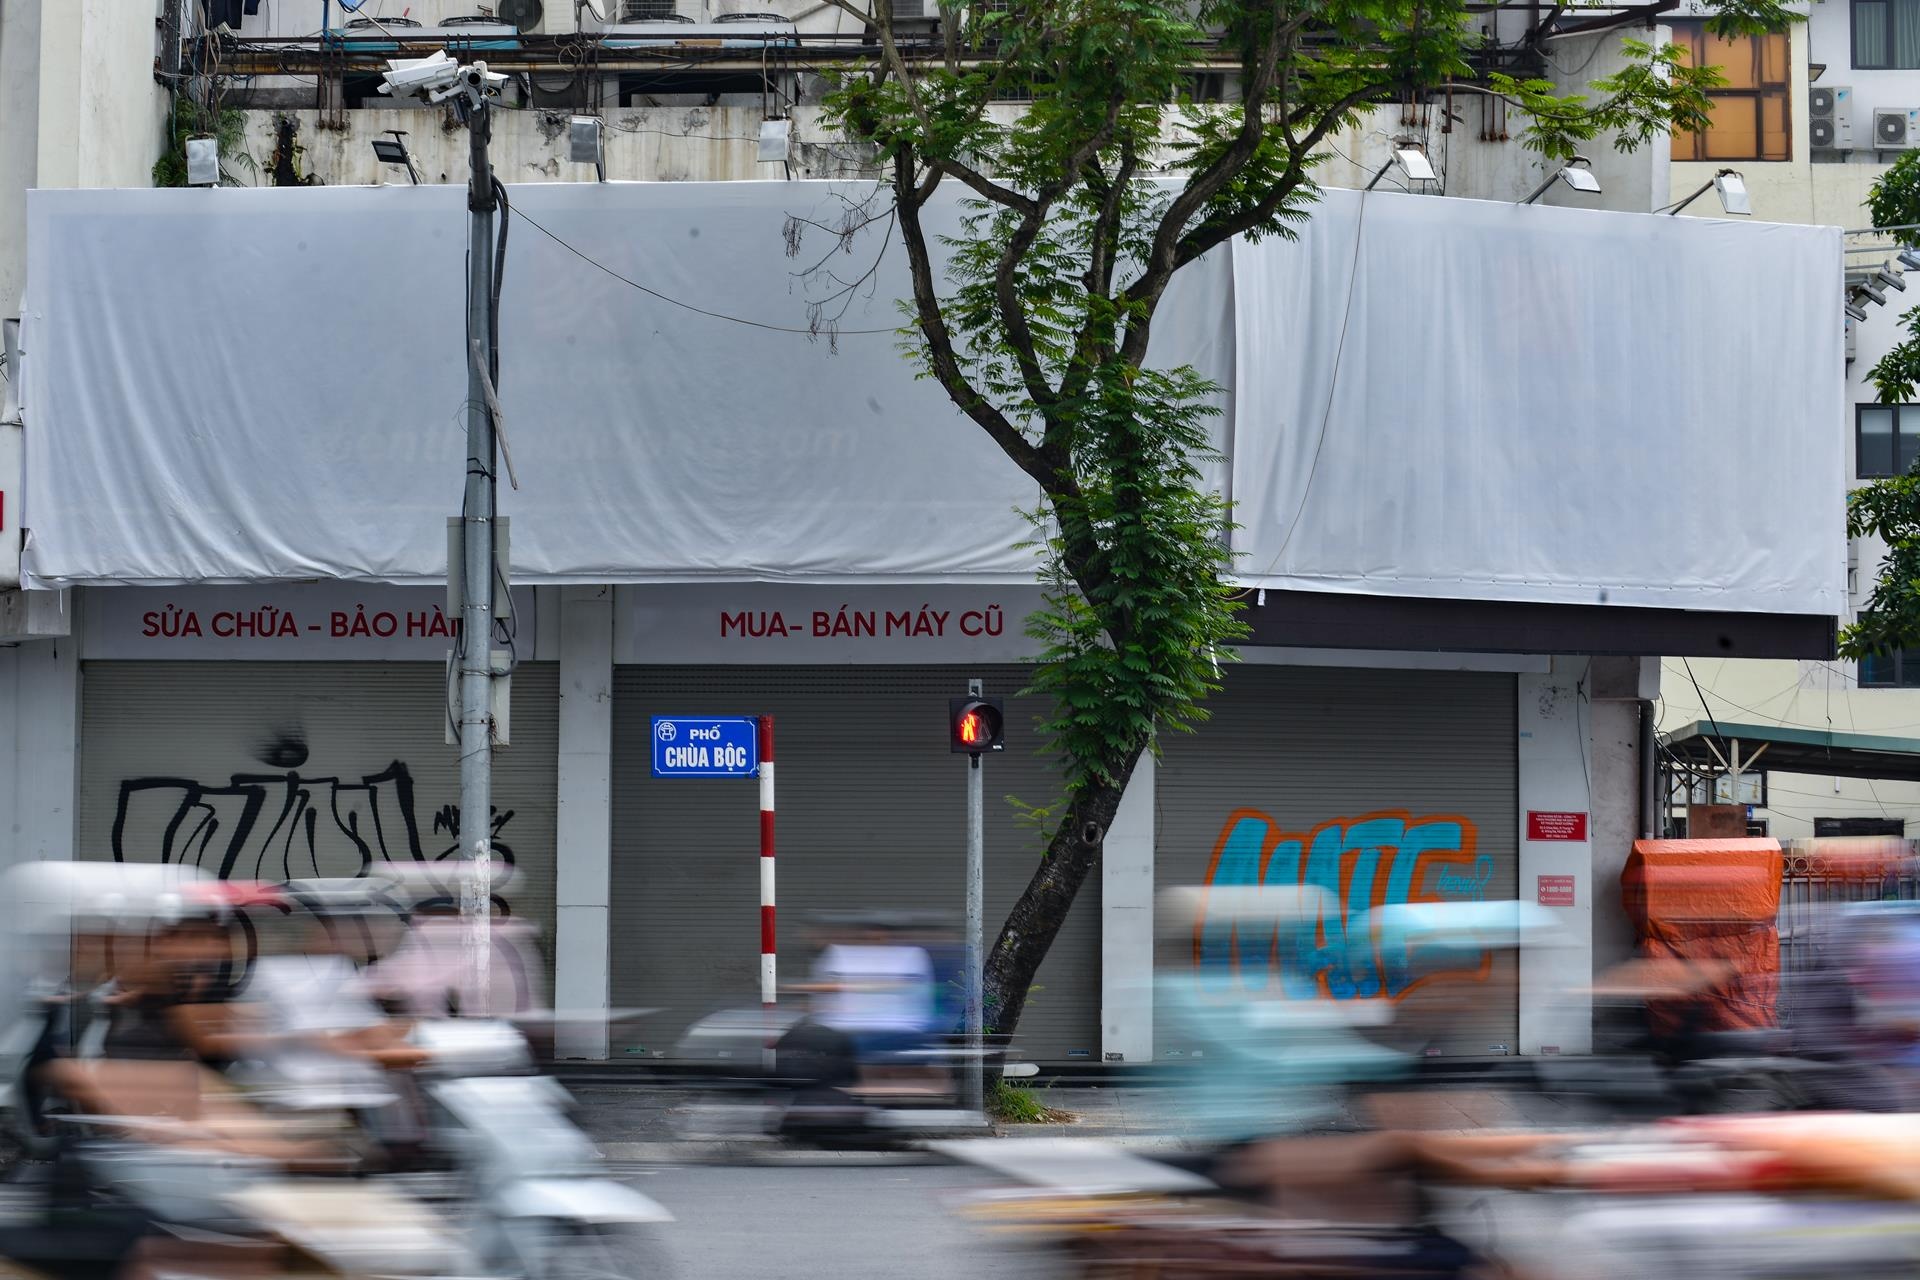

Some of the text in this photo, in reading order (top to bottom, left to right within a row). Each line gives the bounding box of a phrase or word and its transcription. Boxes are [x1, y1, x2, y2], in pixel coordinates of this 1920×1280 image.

[142, 603, 202, 638] SỬA
[211, 605, 298, 638] CHỮA
[330, 603, 398, 638] BẢO
[812, 603, 877, 638] BÁN
[885, 603, 951, 638] MÁY
[959, 603, 1004, 638] CŨ
[689, 724, 721, 740] PHỐ
[665, 742, 748, 772] CHÙA BỘC
